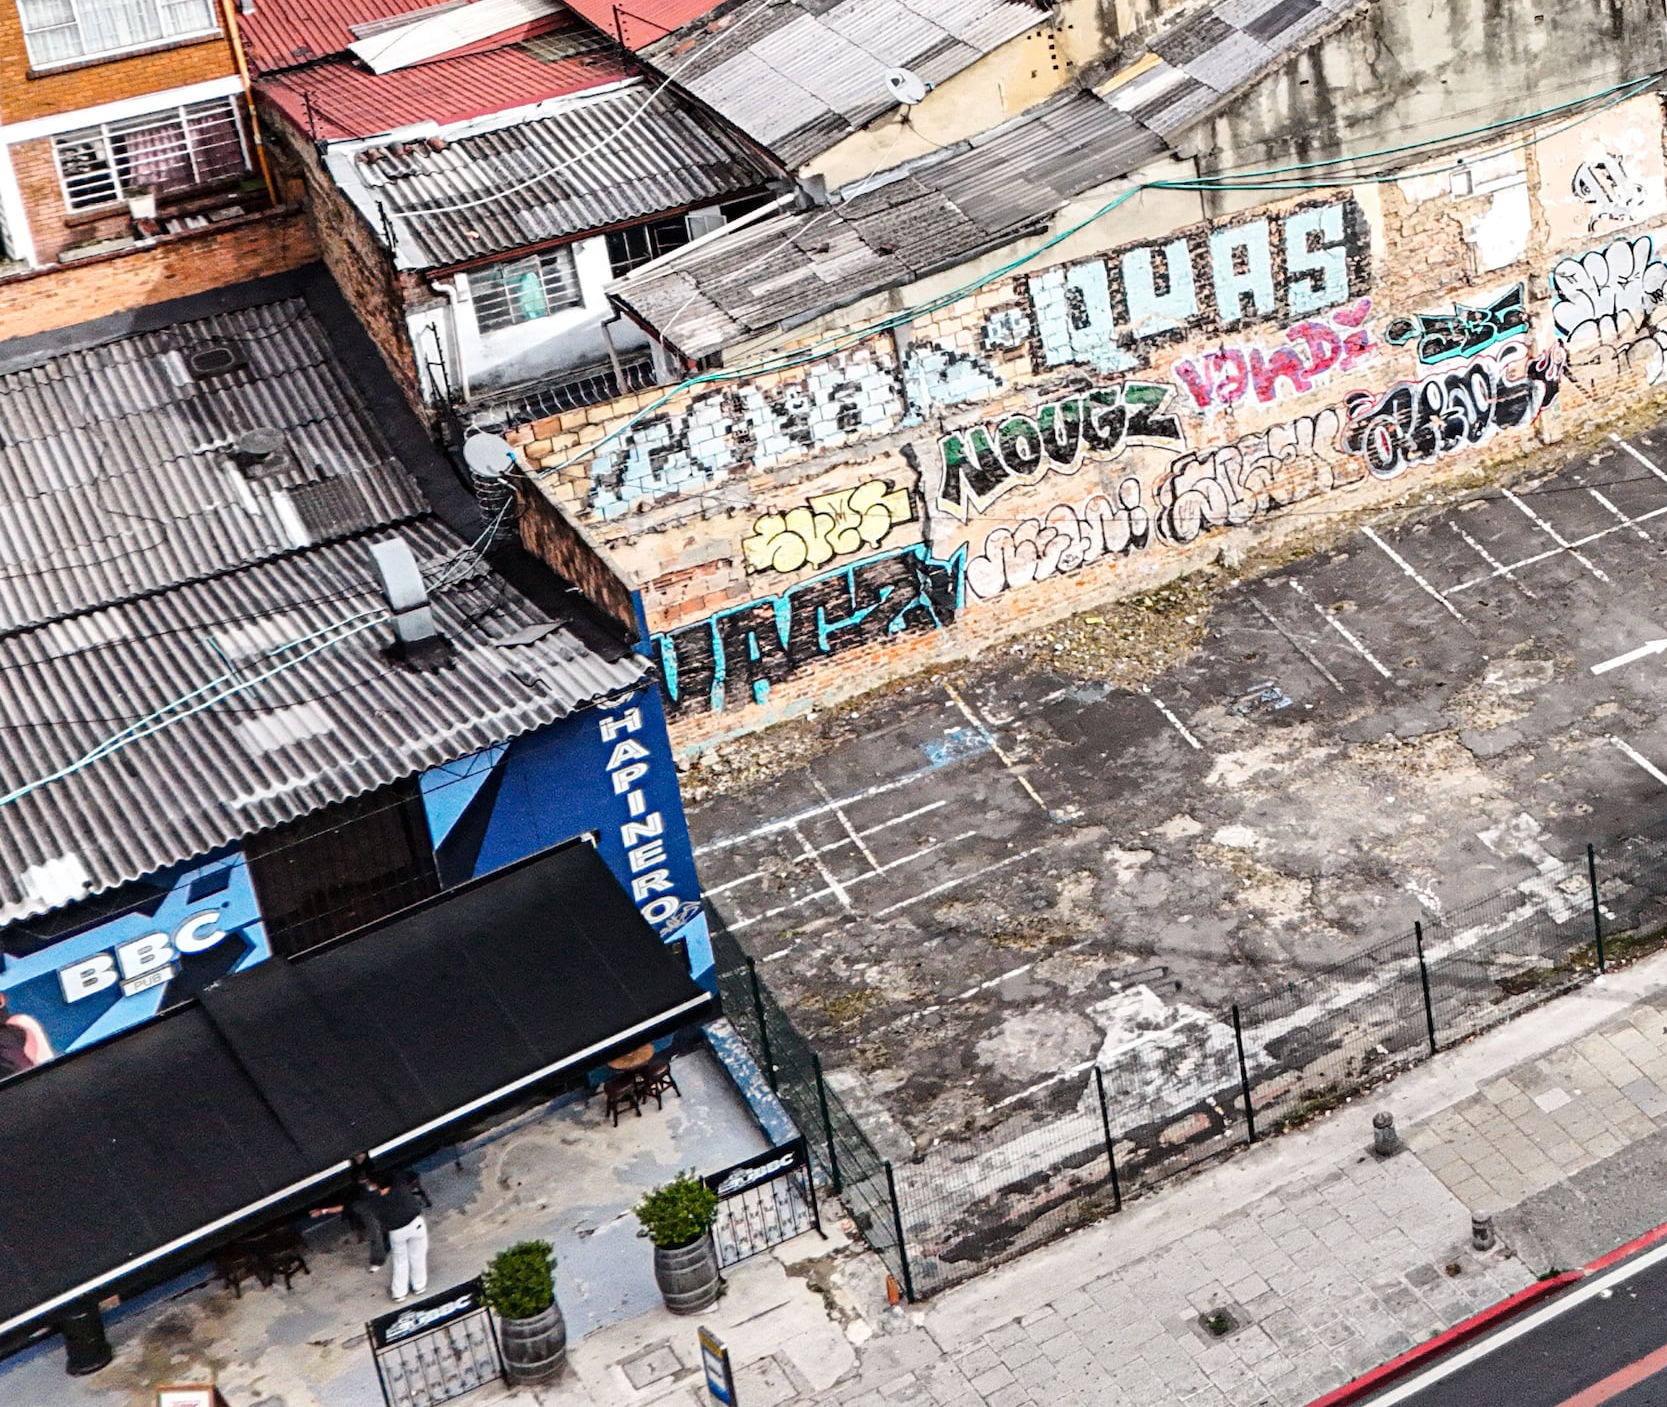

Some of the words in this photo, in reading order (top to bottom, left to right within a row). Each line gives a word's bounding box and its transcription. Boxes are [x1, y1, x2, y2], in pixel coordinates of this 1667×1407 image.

[936, 379, 1186, 524] NOUGZ
[58, 910, 227, 1003] BBC
[133, 973, 163, 991] PUB
